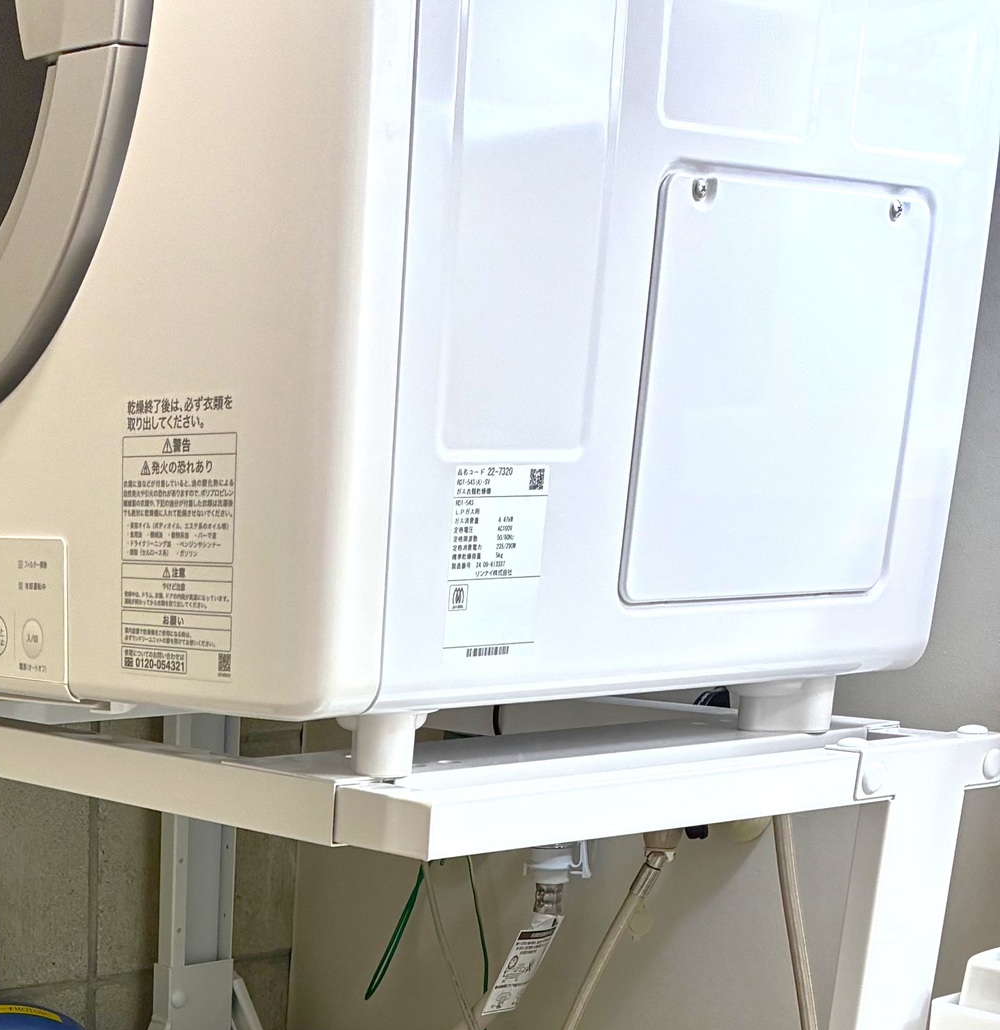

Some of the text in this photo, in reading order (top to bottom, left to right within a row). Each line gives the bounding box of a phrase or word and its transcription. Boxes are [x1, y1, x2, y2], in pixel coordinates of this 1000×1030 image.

[127, 395, 232, 415] 乾燥終了後は、必ず衣類を
[127, 415, 204, 431] 取り出してください。
[173, 438, 190, 452] 警告
[152, 460, 212, 474] 発火の恐れあり
[487, 467, 513, 476] 22-7320
[172, 568, 185, 578] 注意
[162, 615, 184, 626] お願い
[135, 657, 184, 672] 0120-054321
